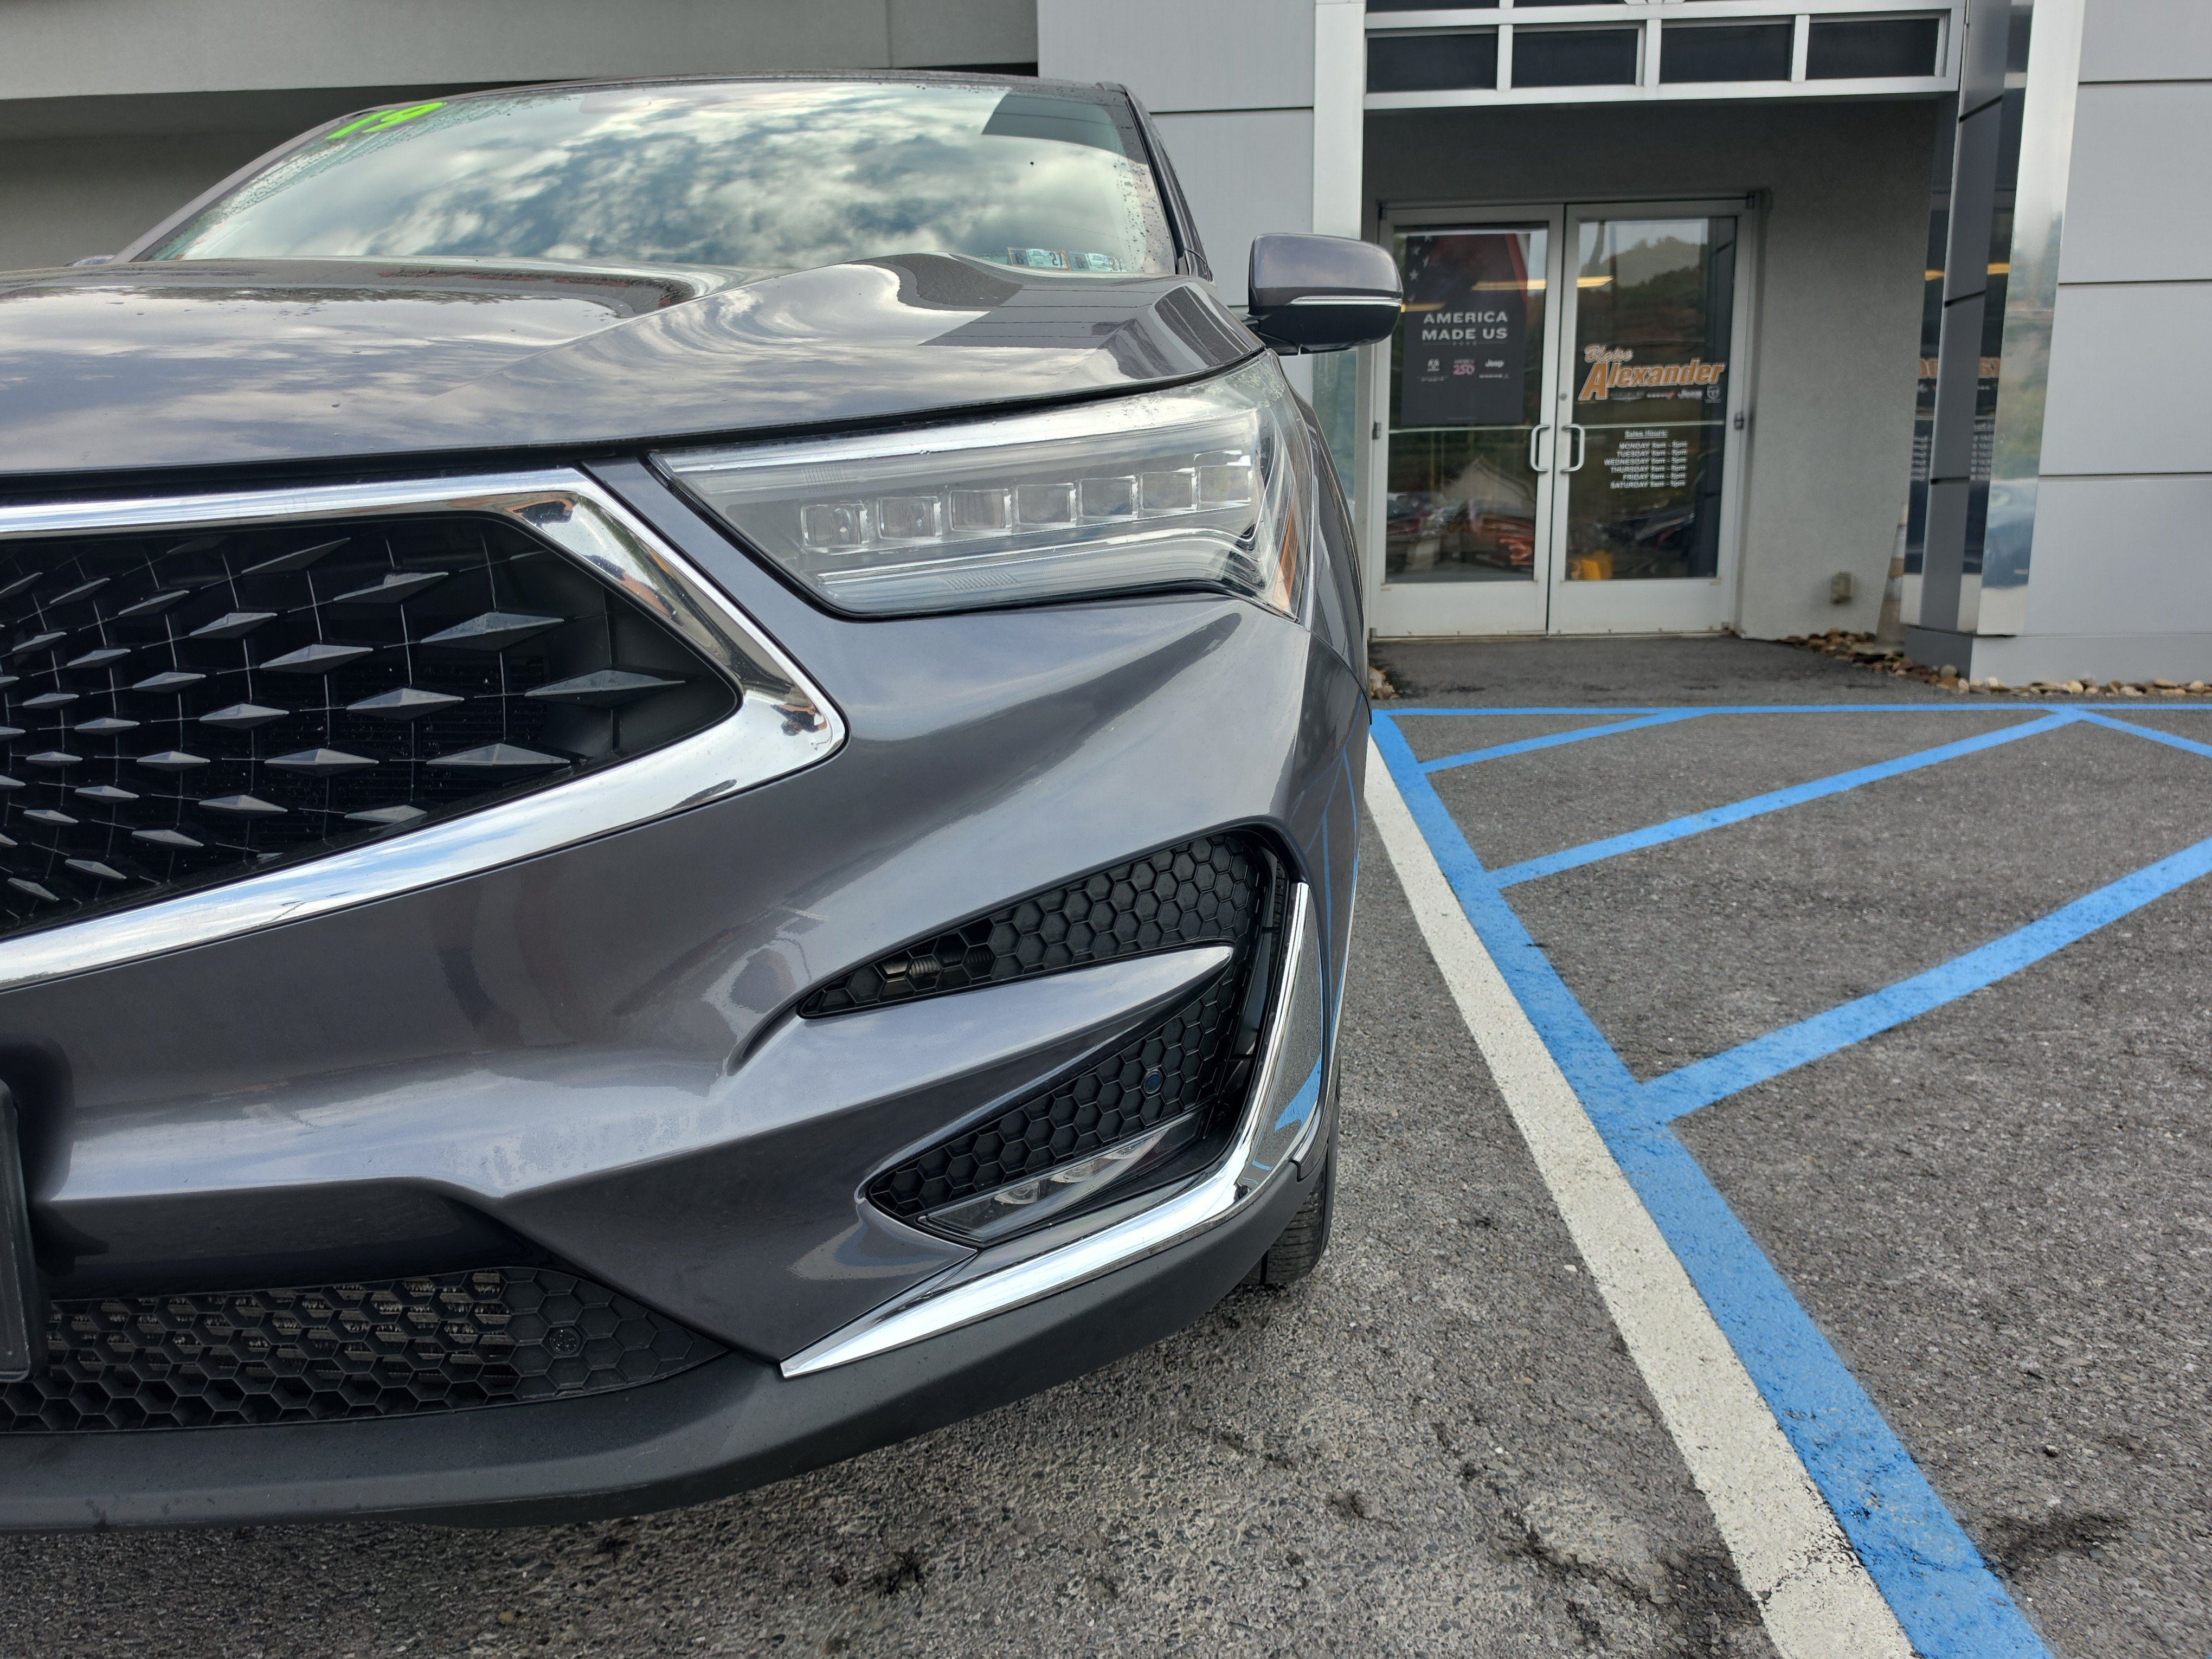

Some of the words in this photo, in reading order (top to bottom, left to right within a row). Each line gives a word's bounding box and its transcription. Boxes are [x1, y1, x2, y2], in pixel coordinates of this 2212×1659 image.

[1049, 252, 1063, 267] 21
[1423, 310, 1508, 324] AMERICA
[1422, 327, 1476, 340] MADE
[1482, 327, 1508, 339] US
[1584, 343, 1635, 363] Blaise
[1453, 363, 1476, 375] 250
[1485, 359, 1505, 368] Jeep
[1578, 357, 1726, 401] Alexander
[1678, 388, 1703, 400] Jeep
[1624, 429, 1644, 438] Sales
[1644, 429, 1668, 438] Hours:
[1604, 458, 1649, 466] WEDNESDAY
[1611, 465, 1649, 473] THURSDAY
